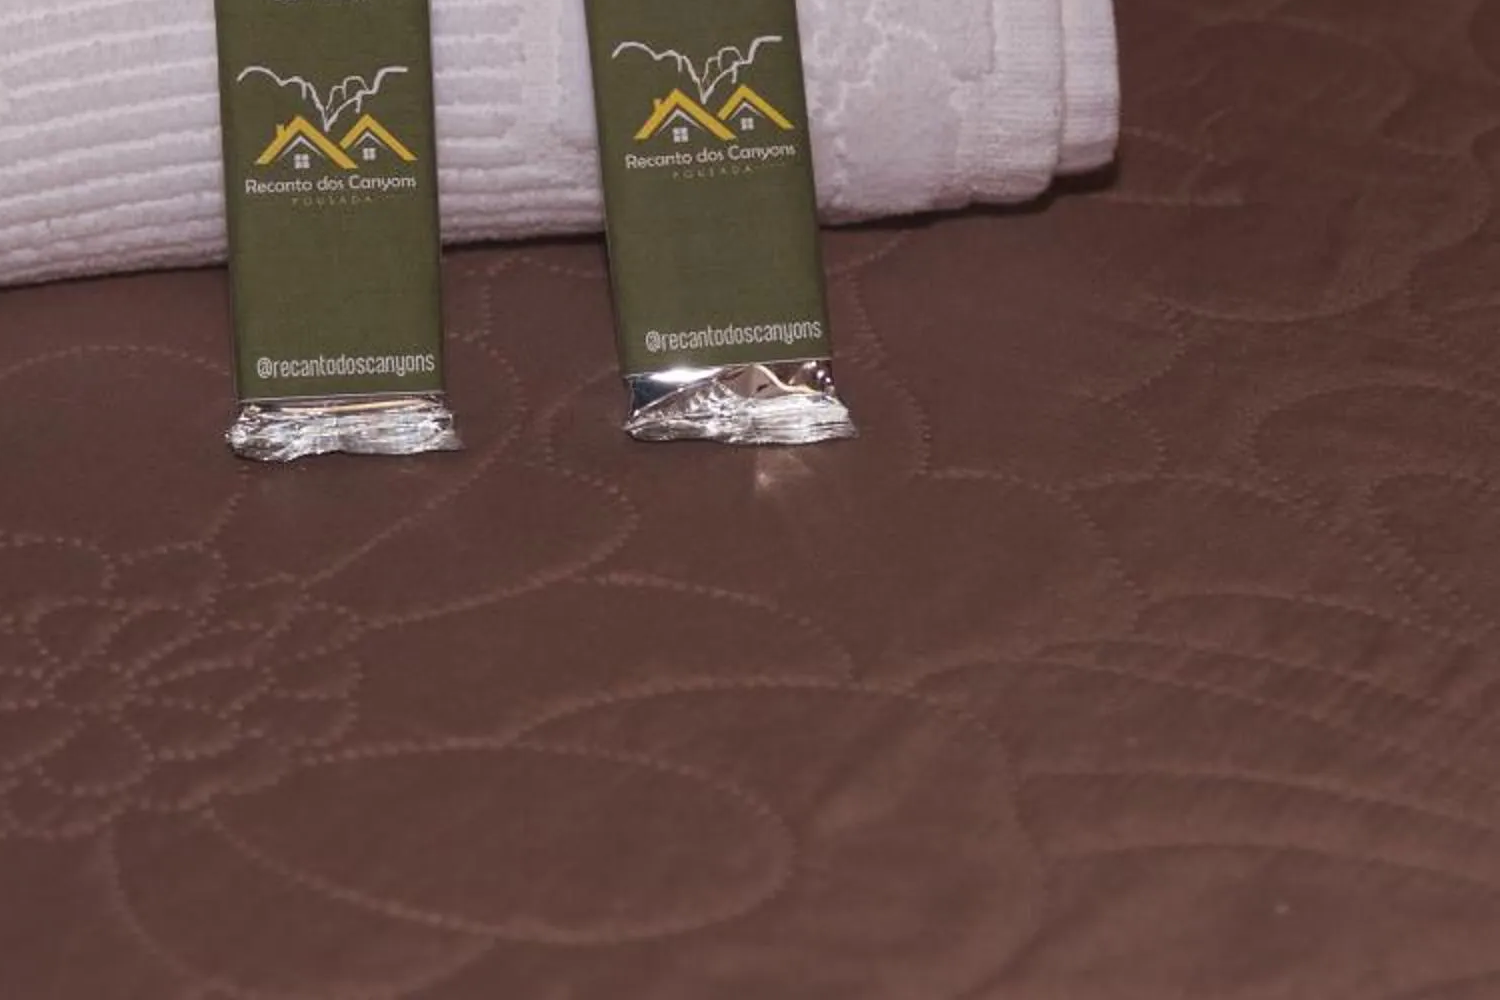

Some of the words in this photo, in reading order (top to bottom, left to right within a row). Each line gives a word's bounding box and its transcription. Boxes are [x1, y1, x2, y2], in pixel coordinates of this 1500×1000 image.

[624, 153, 692, 169] Recanto
[696, 147, 724, 163] dos
[727, 144, 796, 161] Canyons
[244, 179, 312, 194] Recanto
[316, 175, 344, 191] dos
[348, 174, 417, 191] Canyons
[645, 320, 822, 352] @recantodoscanyons
[257, 353, 435, 379] @recantodoscanyons
